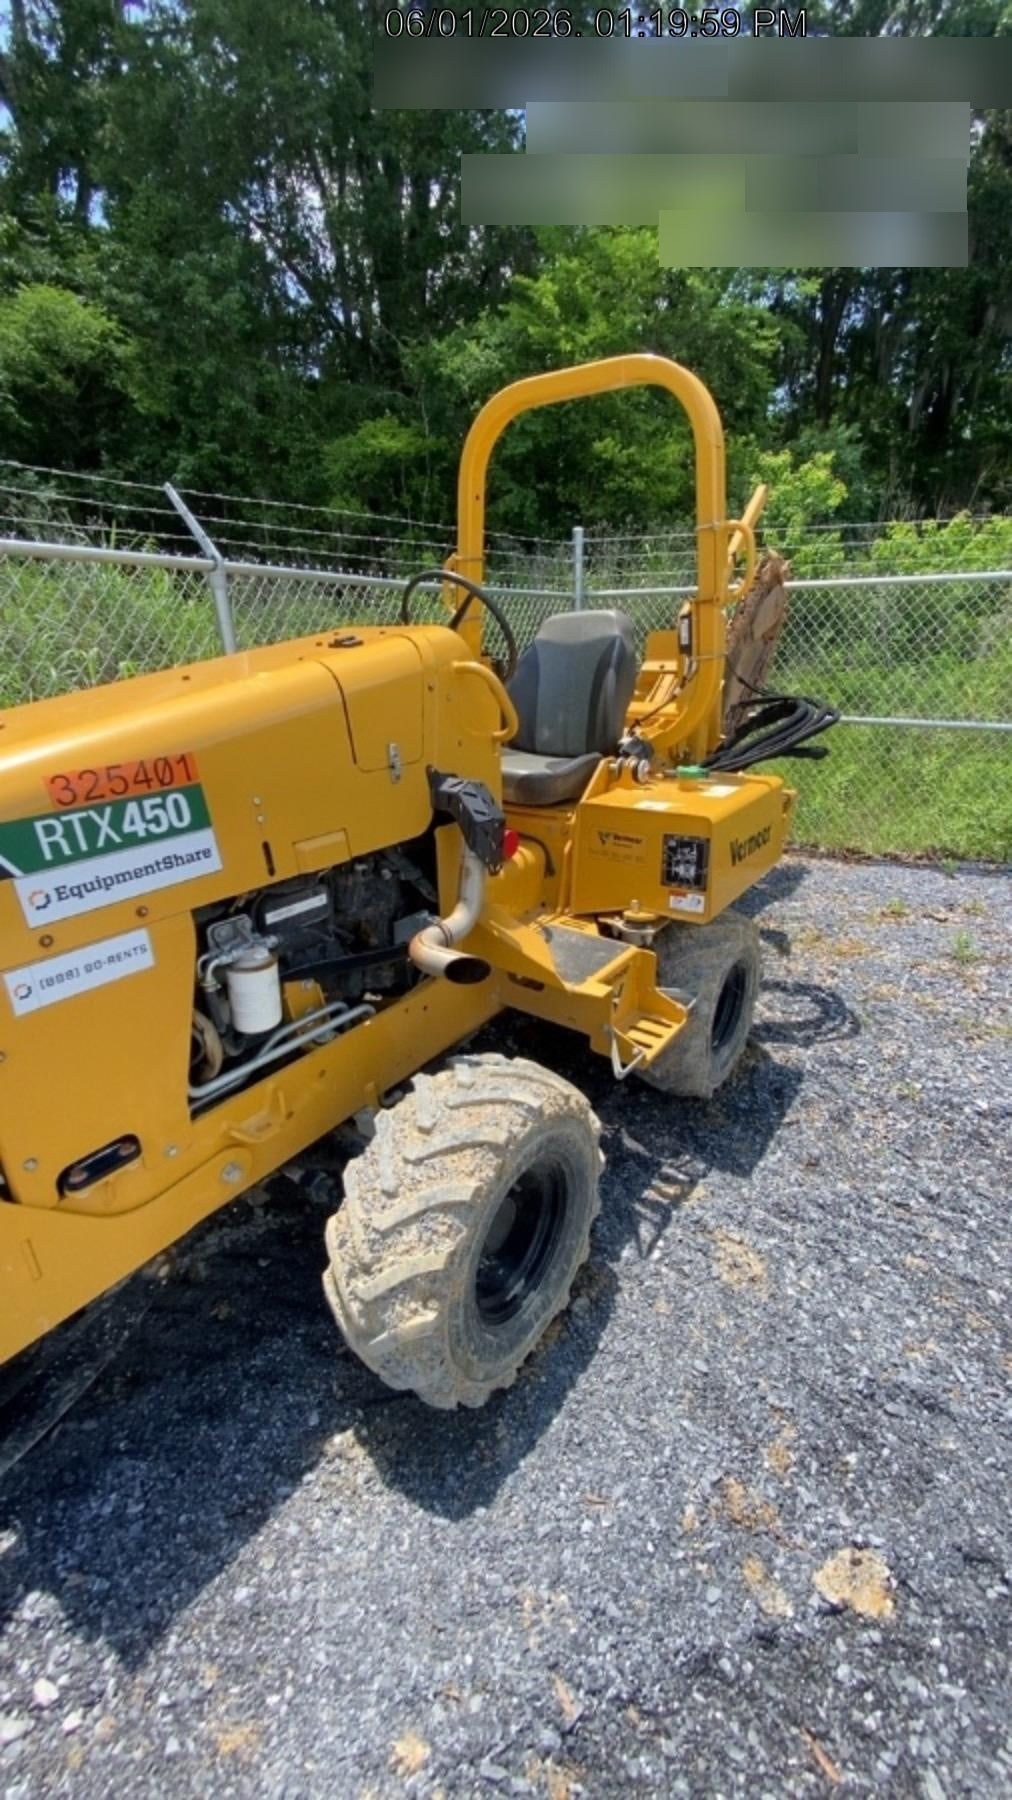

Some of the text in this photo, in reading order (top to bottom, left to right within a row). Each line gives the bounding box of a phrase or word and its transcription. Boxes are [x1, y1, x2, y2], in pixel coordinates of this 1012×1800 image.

[50, 753, 194, 806] 325401
[34, 792, 191, 861] RTX450
[729, 823, 771, 867] Vermeer
[54, 846, 213, 903] EquipmentShare
